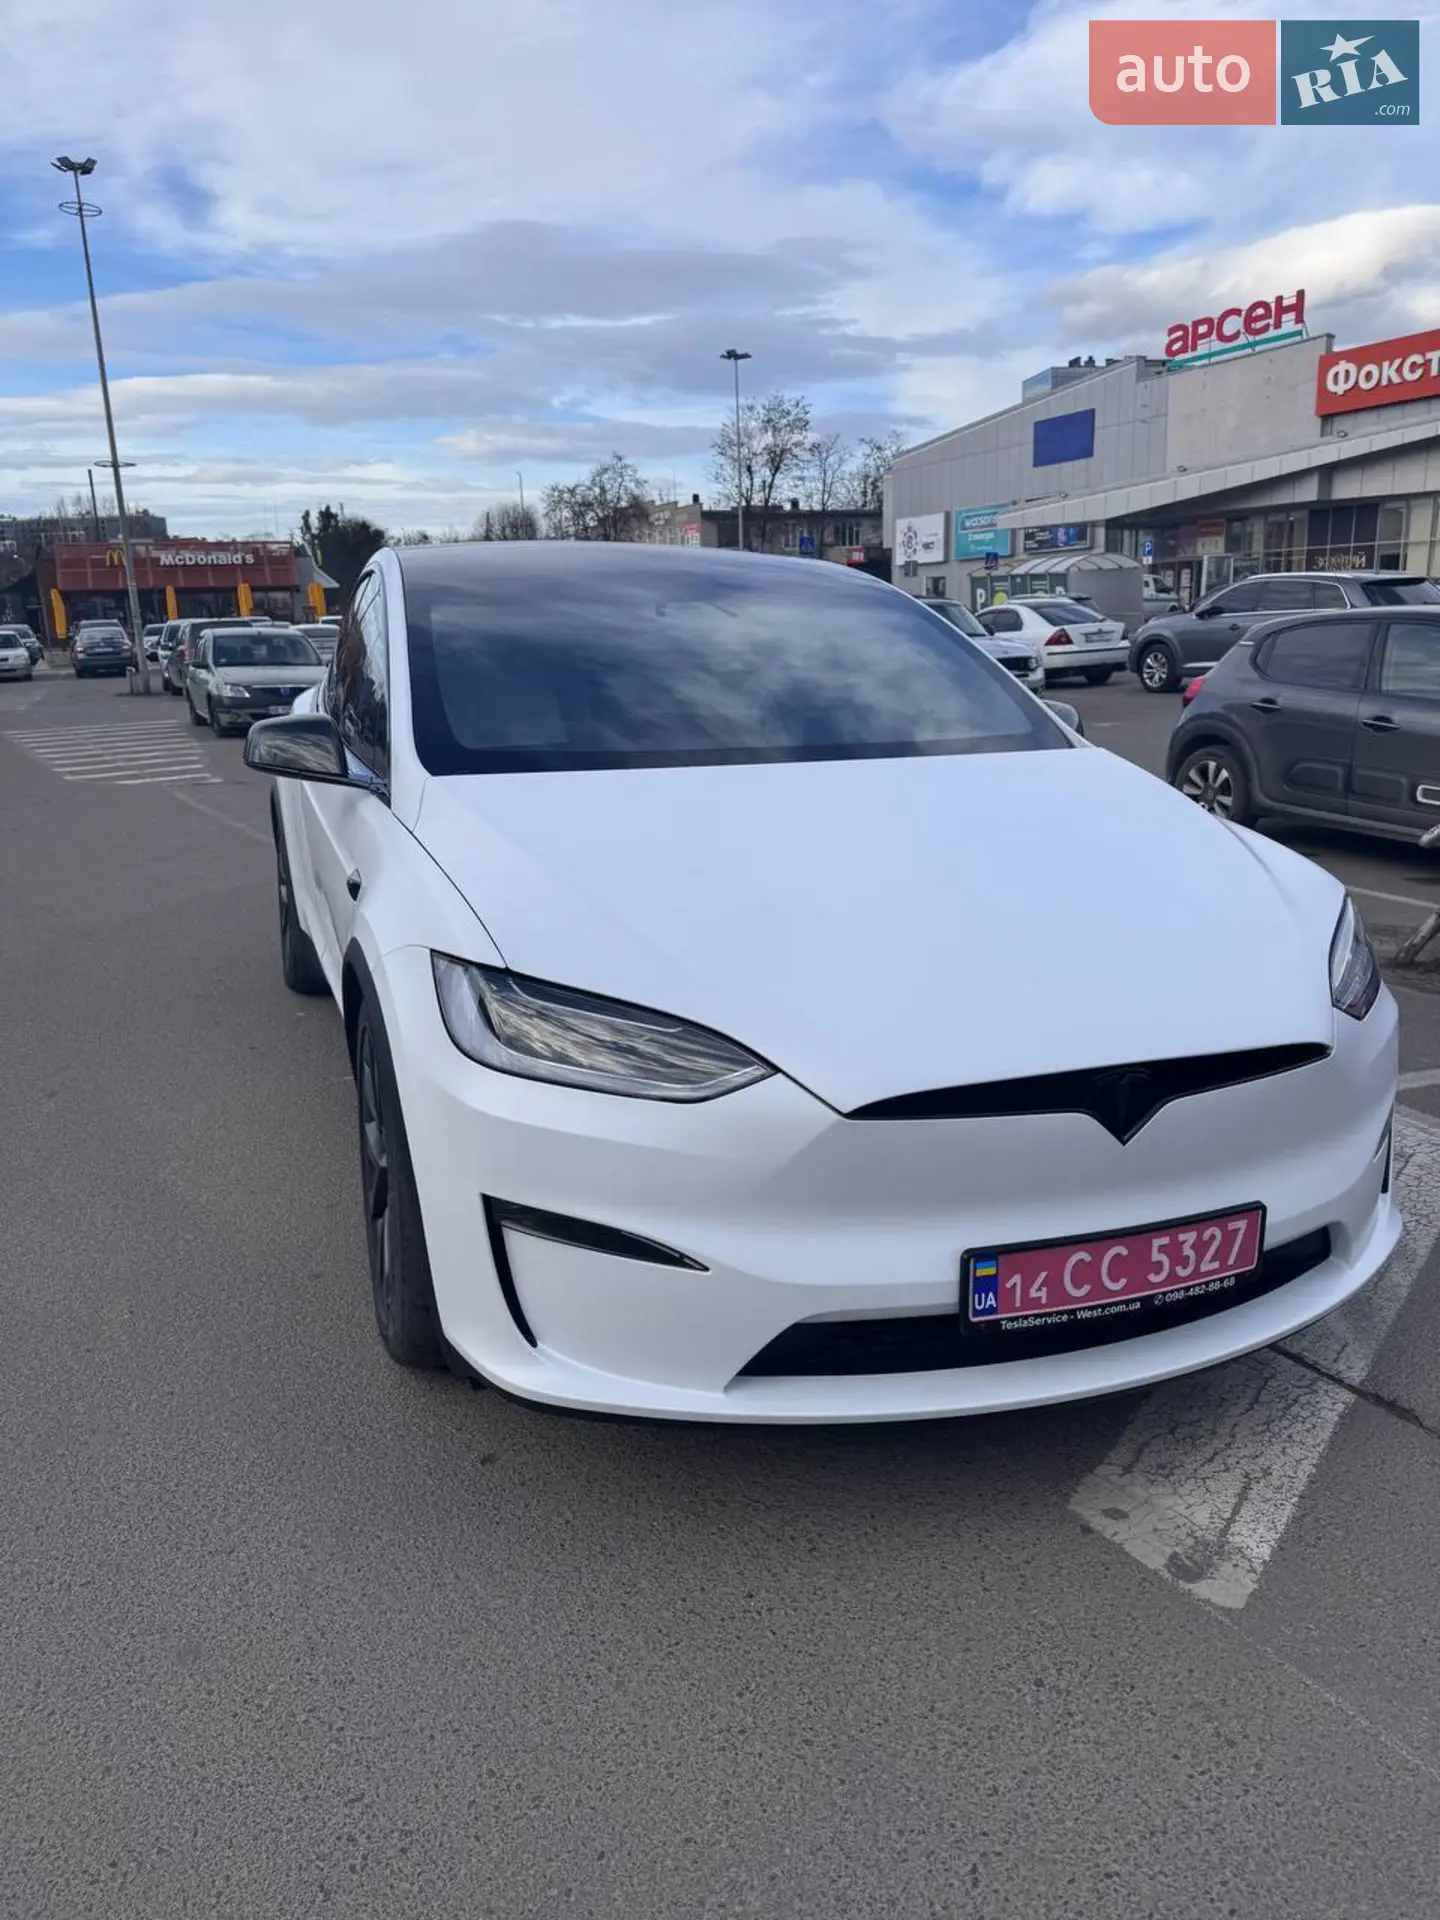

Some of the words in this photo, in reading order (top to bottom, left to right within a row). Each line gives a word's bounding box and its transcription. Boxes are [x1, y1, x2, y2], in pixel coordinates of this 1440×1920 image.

[159, 552, 254, 566] McDonald's
[1005, 1271, 1049, 1308] 14
[1063, 1246, 1129, 1297] CC
[1147, 1219, 1248, 1284] 5327
[974, 1291, 997, 1310] UA
[1001, 1313, 1069, 1330] TeslaService
[1076, 1301, 1141, 1320] West.com.ua
